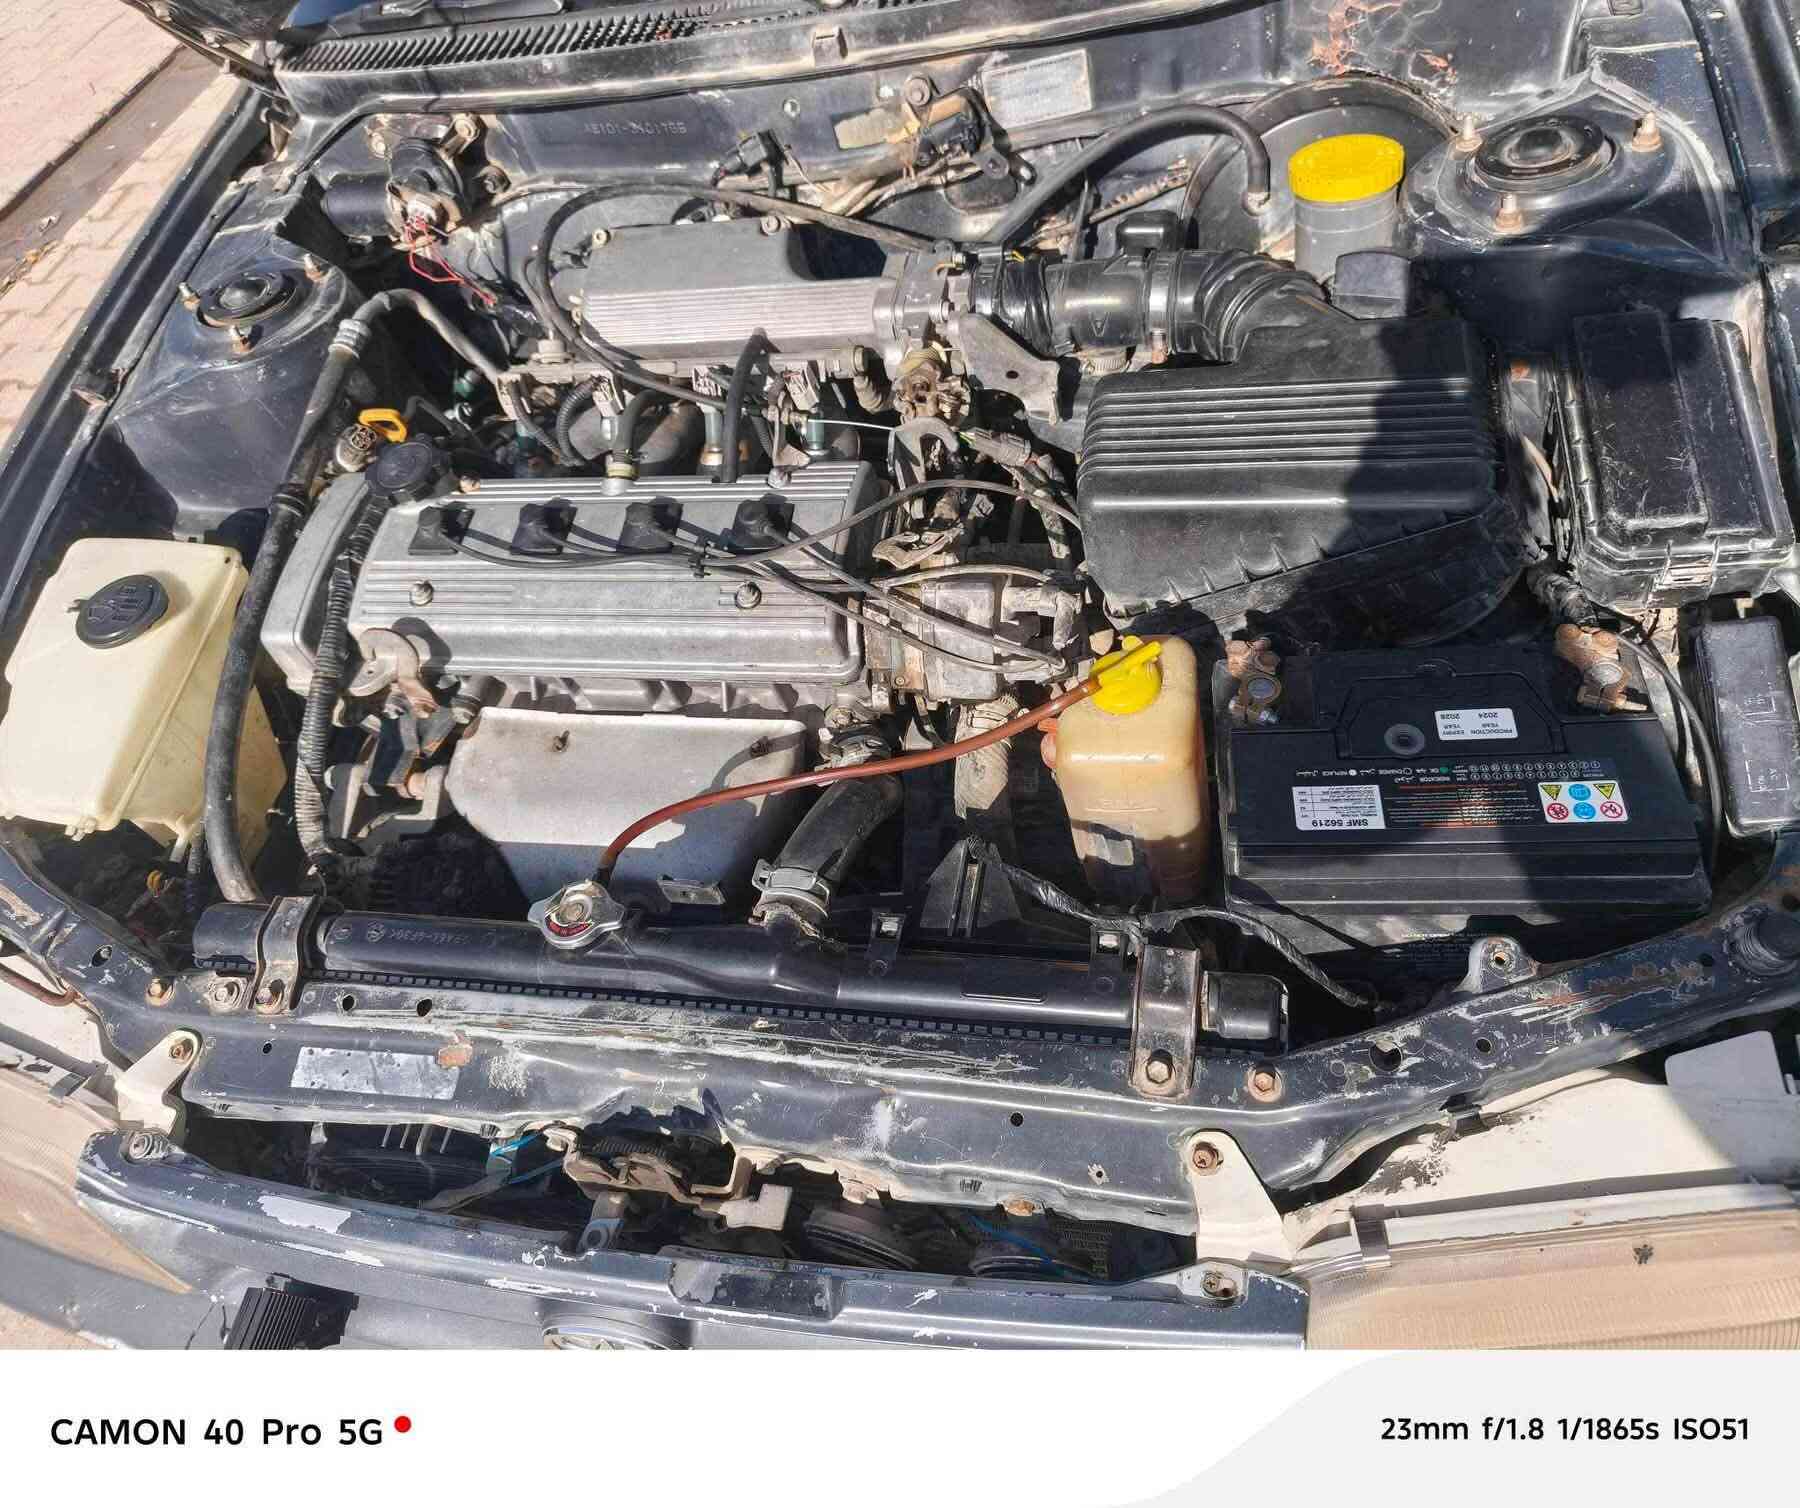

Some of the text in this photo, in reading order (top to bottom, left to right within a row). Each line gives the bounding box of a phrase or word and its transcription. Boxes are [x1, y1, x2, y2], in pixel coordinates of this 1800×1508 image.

[1478, 711, 1499, 719] 2024
[1470, 728, 1513, 736] PRODUCTION
[1311, 818, 1369, 828] SMF 56219
